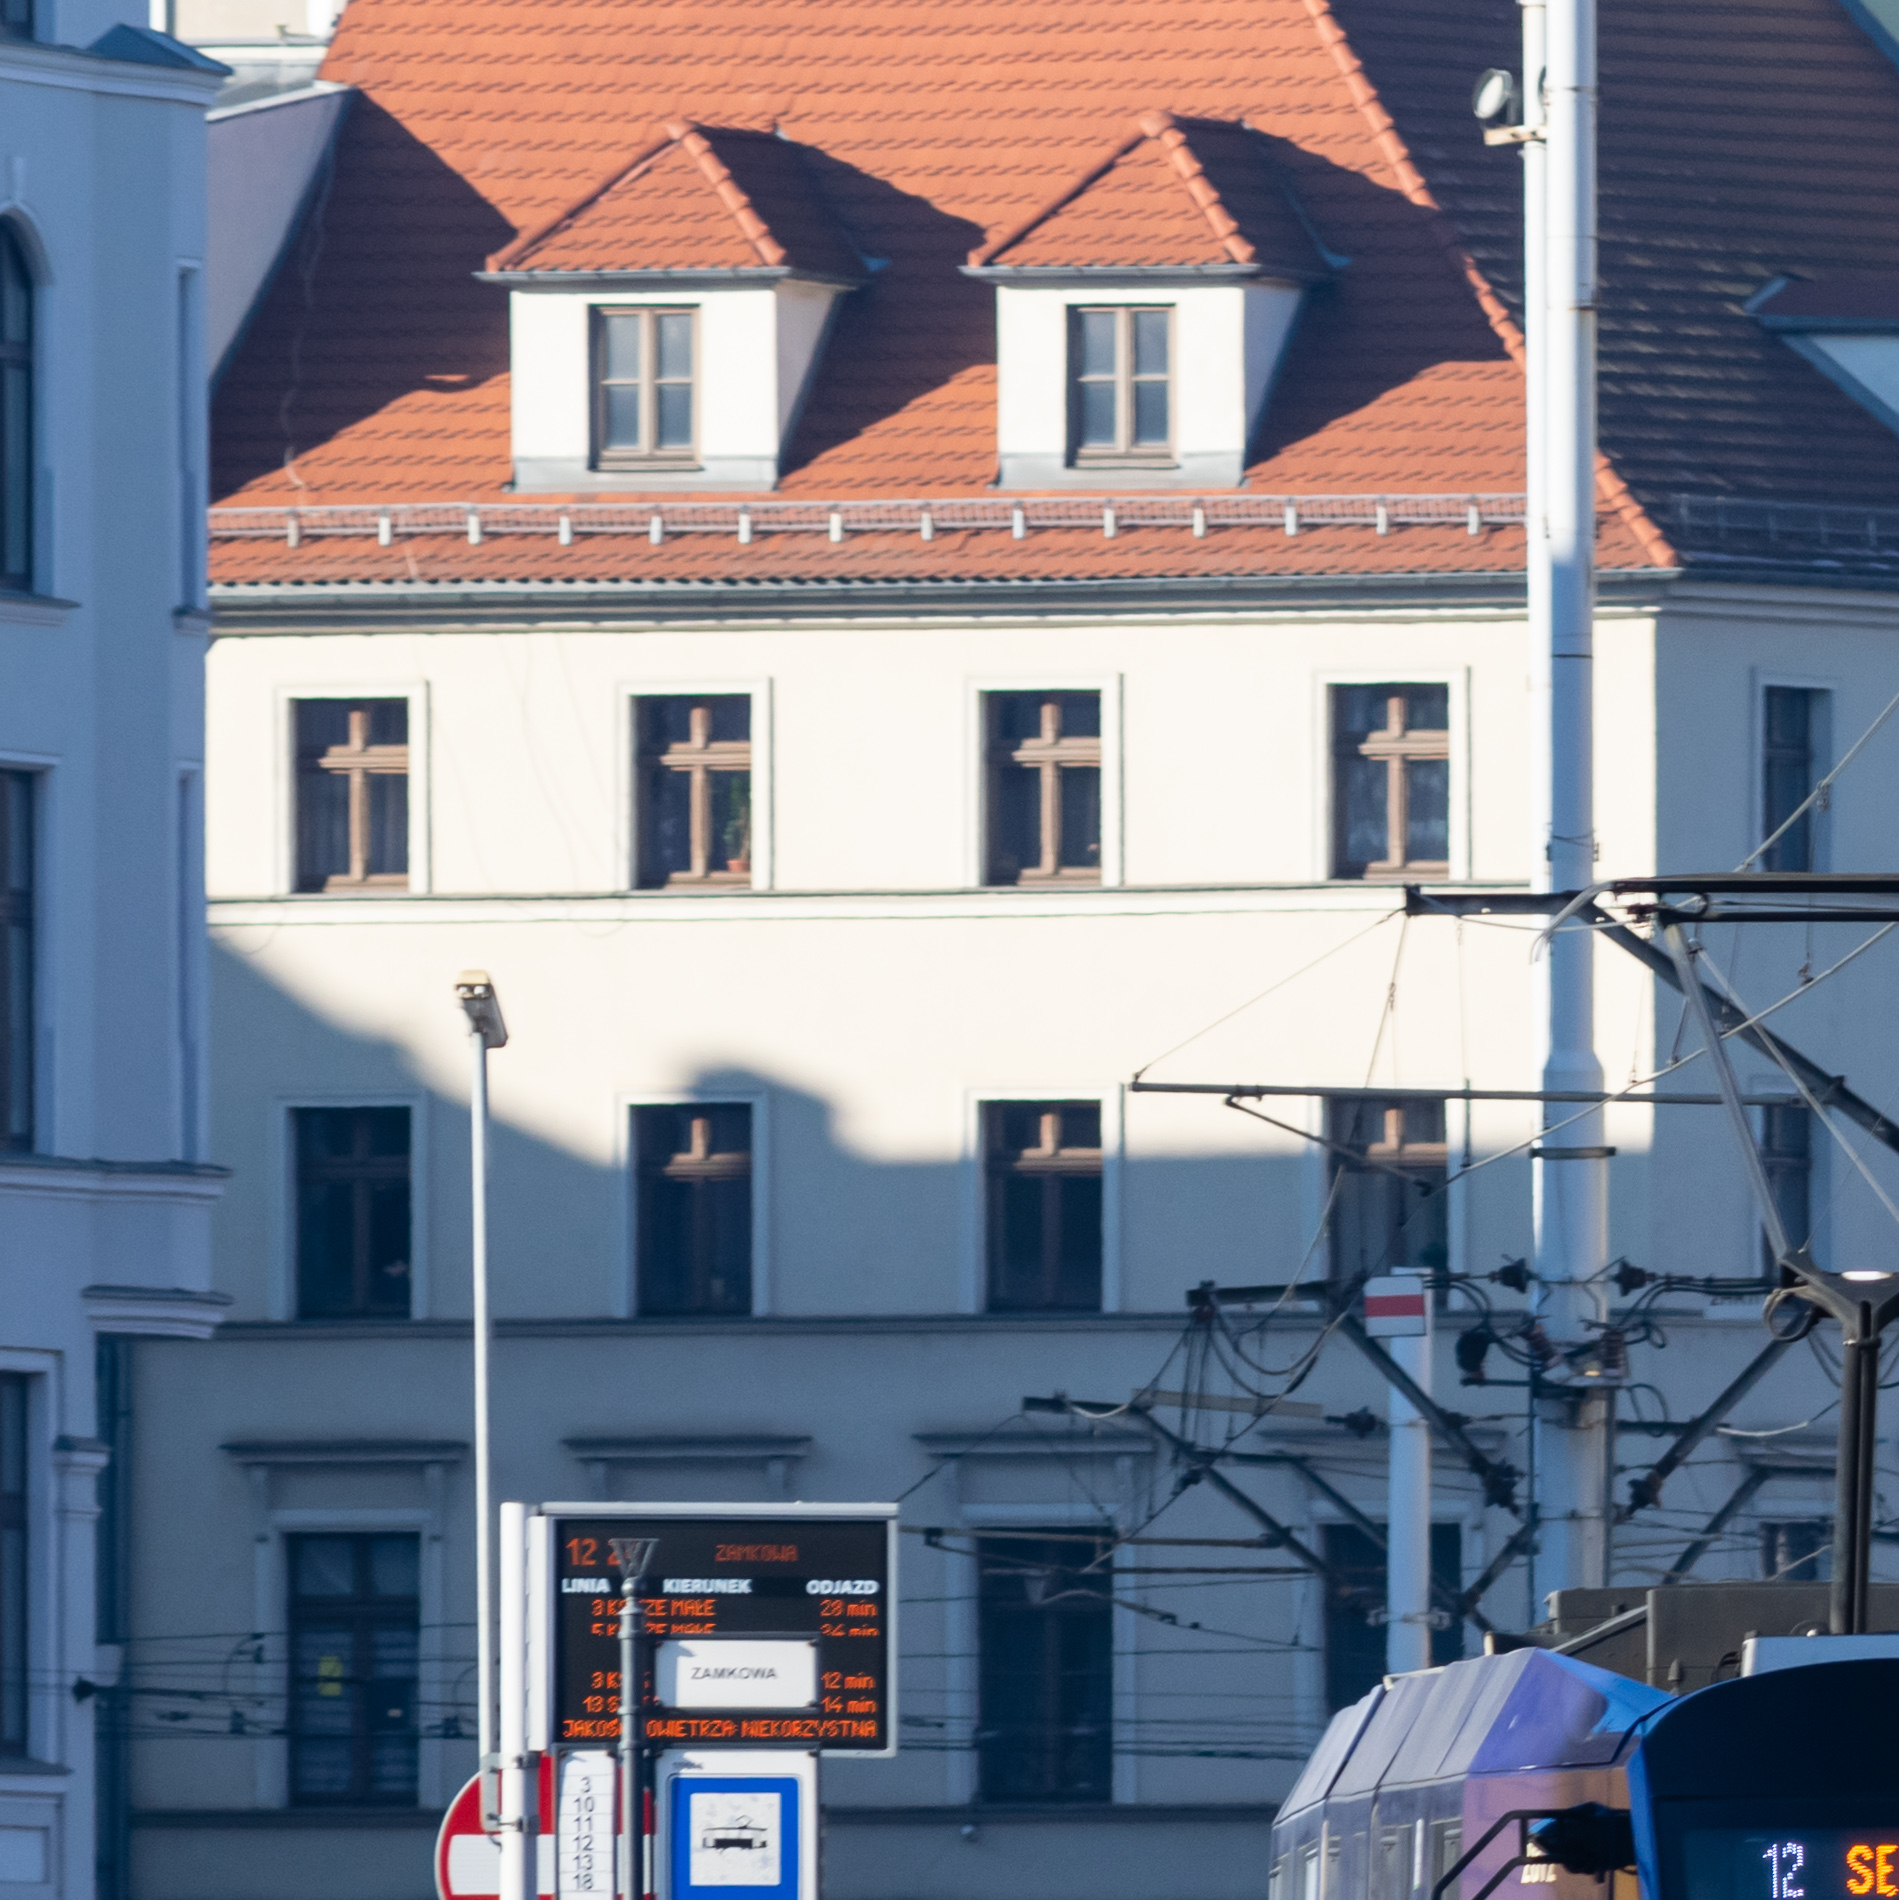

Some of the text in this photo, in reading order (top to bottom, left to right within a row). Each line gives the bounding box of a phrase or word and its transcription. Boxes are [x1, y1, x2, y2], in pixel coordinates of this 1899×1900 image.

[565, 1538, 599, 1566] 12
[714, 1544, 799, 1563] ZAMKOWA
[562, 1577, 881, 1595] LINIA KIERUNEK ODJAZD
[591, 1599, 603, 1616] 3
[846, 1599, 878, 1617] min
[690, 1666, 779, 1680] ZAMKOWA
[820, 1671, 842, 1690] 12
[843, 1671, 877, 1690] min
[820, 1696, 844, 1714] 14
[846, 1696, 878, 1714] min
[740, 1719, 878, 1738] NIEKORZYSTNA
[580, 1776, 592, 1794] 3
[573, 1796, 595, 1813] 10
[573, 1816, 593, 1833] 11
[573, 1835, 594, 1852] 12
[573, 1855, 593, 1871] 13
[1762, 1842, 1804, 1899] 12
[573, 1874, 594, 1890] 18
